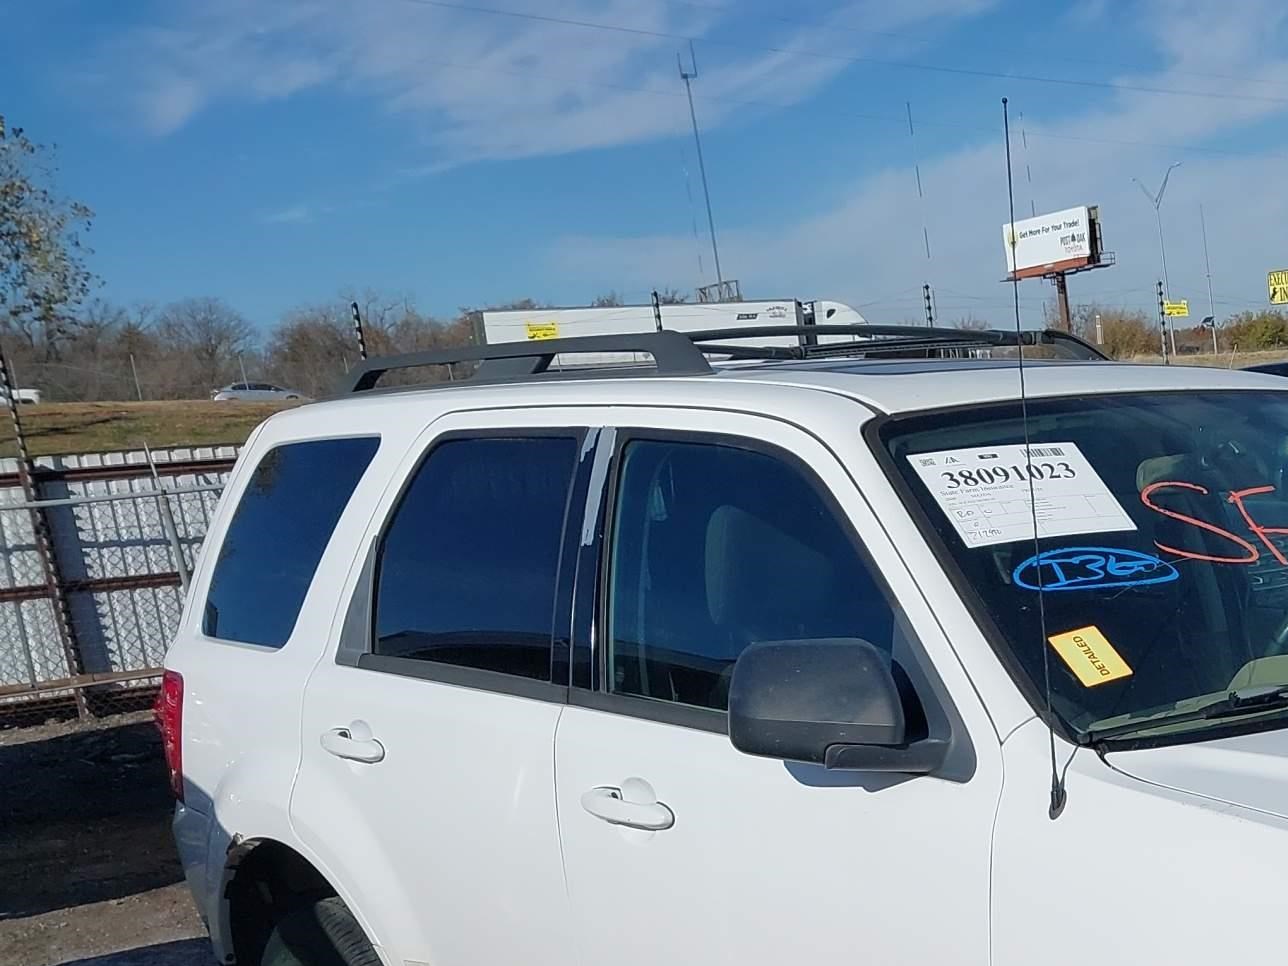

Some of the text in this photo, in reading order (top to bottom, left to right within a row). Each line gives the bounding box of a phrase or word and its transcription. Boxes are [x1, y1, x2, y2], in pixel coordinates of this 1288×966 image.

[1019, 218, 1080, 239] Get More For Your Trade!
[941, 462, 1076, 489] 38091023
[1072, 635, 1110, 676] DETAILED
